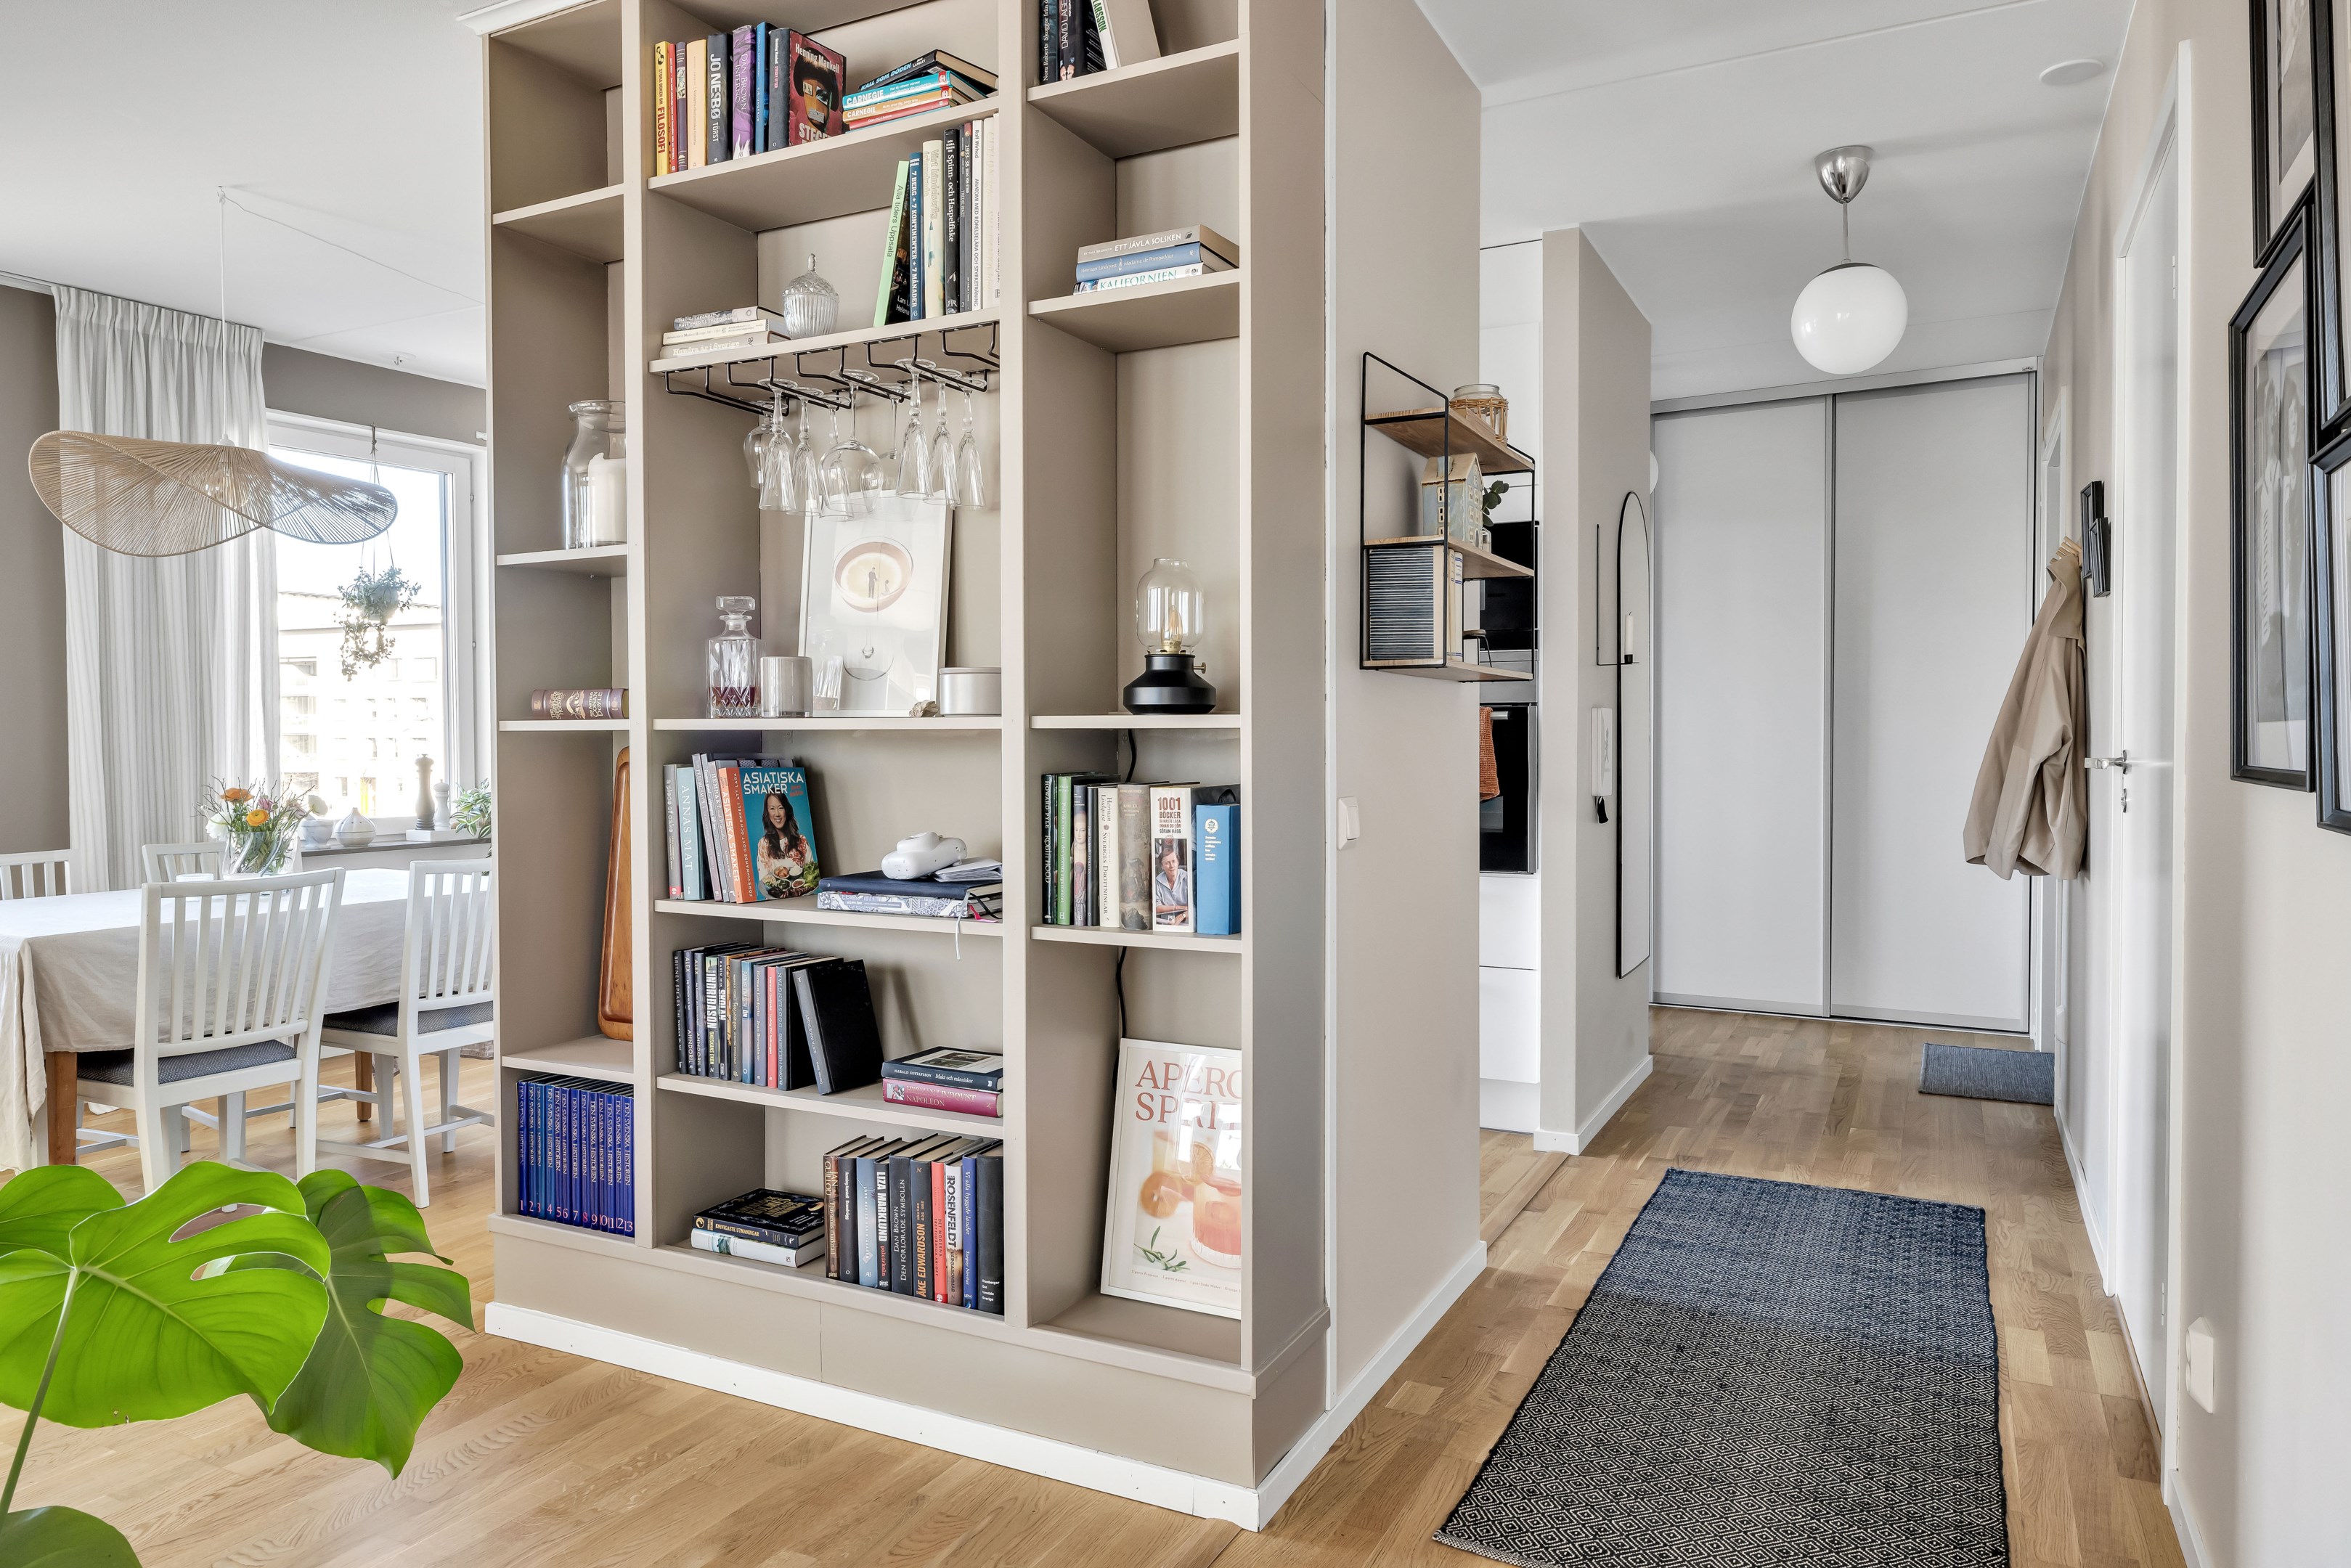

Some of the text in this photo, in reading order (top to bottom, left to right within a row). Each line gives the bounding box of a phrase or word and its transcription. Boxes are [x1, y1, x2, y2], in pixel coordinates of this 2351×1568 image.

[1092, 0, 1107, 33] LARSSON
[795, 44, 839, 74] Henning Mankell
[861, 62, 912, 91] KALL SOM DÖDEN
[710, 54, 722, 120] JO NESBØ
[847, 90, 884, 105] CARNEGIE
[847, 107, 876, 118] CARNEGIE
[799, 123, 832, 139] STEG
[887, 184, 904, 258] Alla tiders Uppsala
[947, 198, 956, 242] Haspelfiske
[1128, 240, 1150, 251] JÄVLA
[1152, 233, 1182, 245] SOLSKEN
[1149, 254, 1173, 263] Pompadour
[1099, 270, 1177, 290] KALIFORNIEN
[672, 346, 698, 356] Hundra
[713, 340, 740, 350] Sverige
[743, 772, 804, 784] ASIATISKA
[712, 772, 721, 809] HEMBAKT
[743, 784, 788, 794] SMAKER
[1157, 797, 1181, 811] 1001
[681, 785, 693, 871] ANNAS MAT
[722, 791, 739, 881] ASIATISKA SMAKER
[744, 854, 754, 897] FÖRSVINNANDE
[706, 973, 717, 1029] INDRIDASON
[906, 1095, 945, 1106] NAPOLEON
[520, 1201, 523, 1211] 1
[529, 1201, 534, 1212] 2
[547, 1204, 552, 1214] 4
[556, 1206, 562, 1217] 5
[563, 1208, 568, 1218] 6
[877, 1172, 887, 1242] LIZA MARKLUND
[947, 1177, 957, 1248] ROSENFELDT
[573, 1211, 578, 1221] 7
[582, 1212, 588, 1222] 8
[591, 1214, 597, 1225] 9
[600, 1215, 607, 1226] 10
[608, 1218, 614, 1228] 11
[616, 1218, 624, 1229] 12
[624, 1220, 633, 1232] 13
[916, 1223, 926, 1297] ÅKE EDWARDSON
